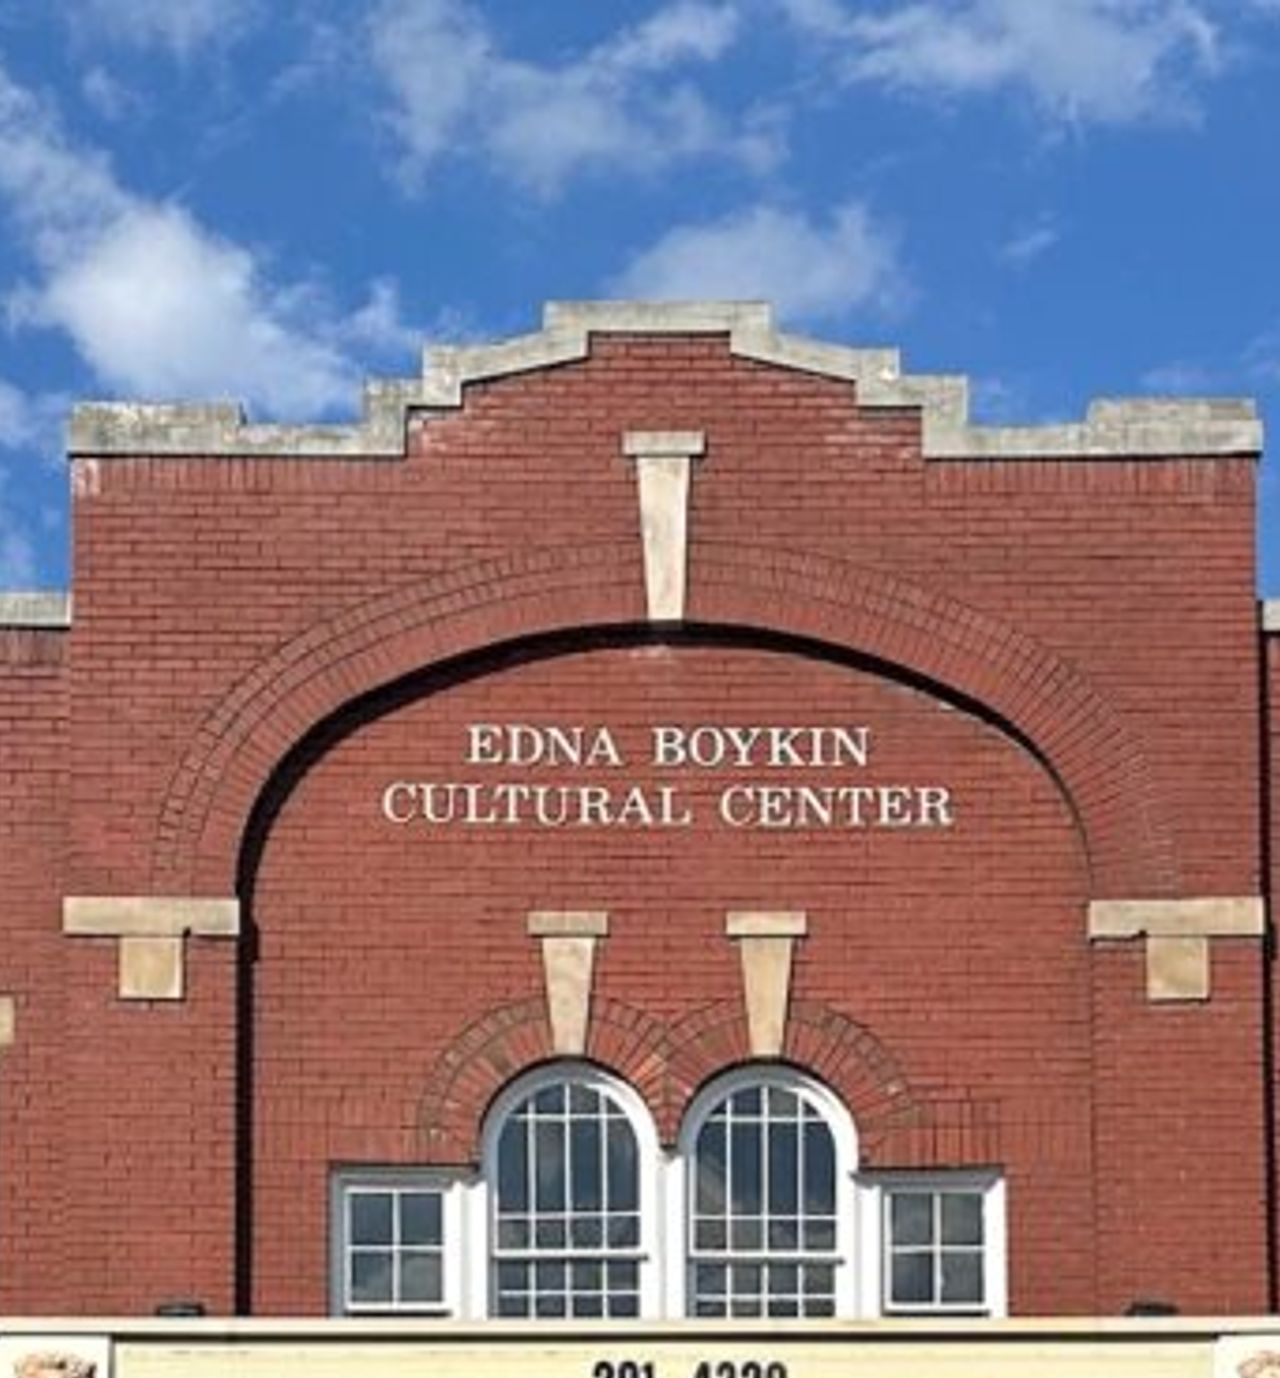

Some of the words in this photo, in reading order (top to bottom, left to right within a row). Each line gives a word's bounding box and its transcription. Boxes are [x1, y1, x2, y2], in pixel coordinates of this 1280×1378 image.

[469, 725, 620, 765] EDNA
[653, 727, 869, 766] BOYKIN
[383, 783, 691, 825] CULTURAL
[721, 785, 952, 826] CENTER
